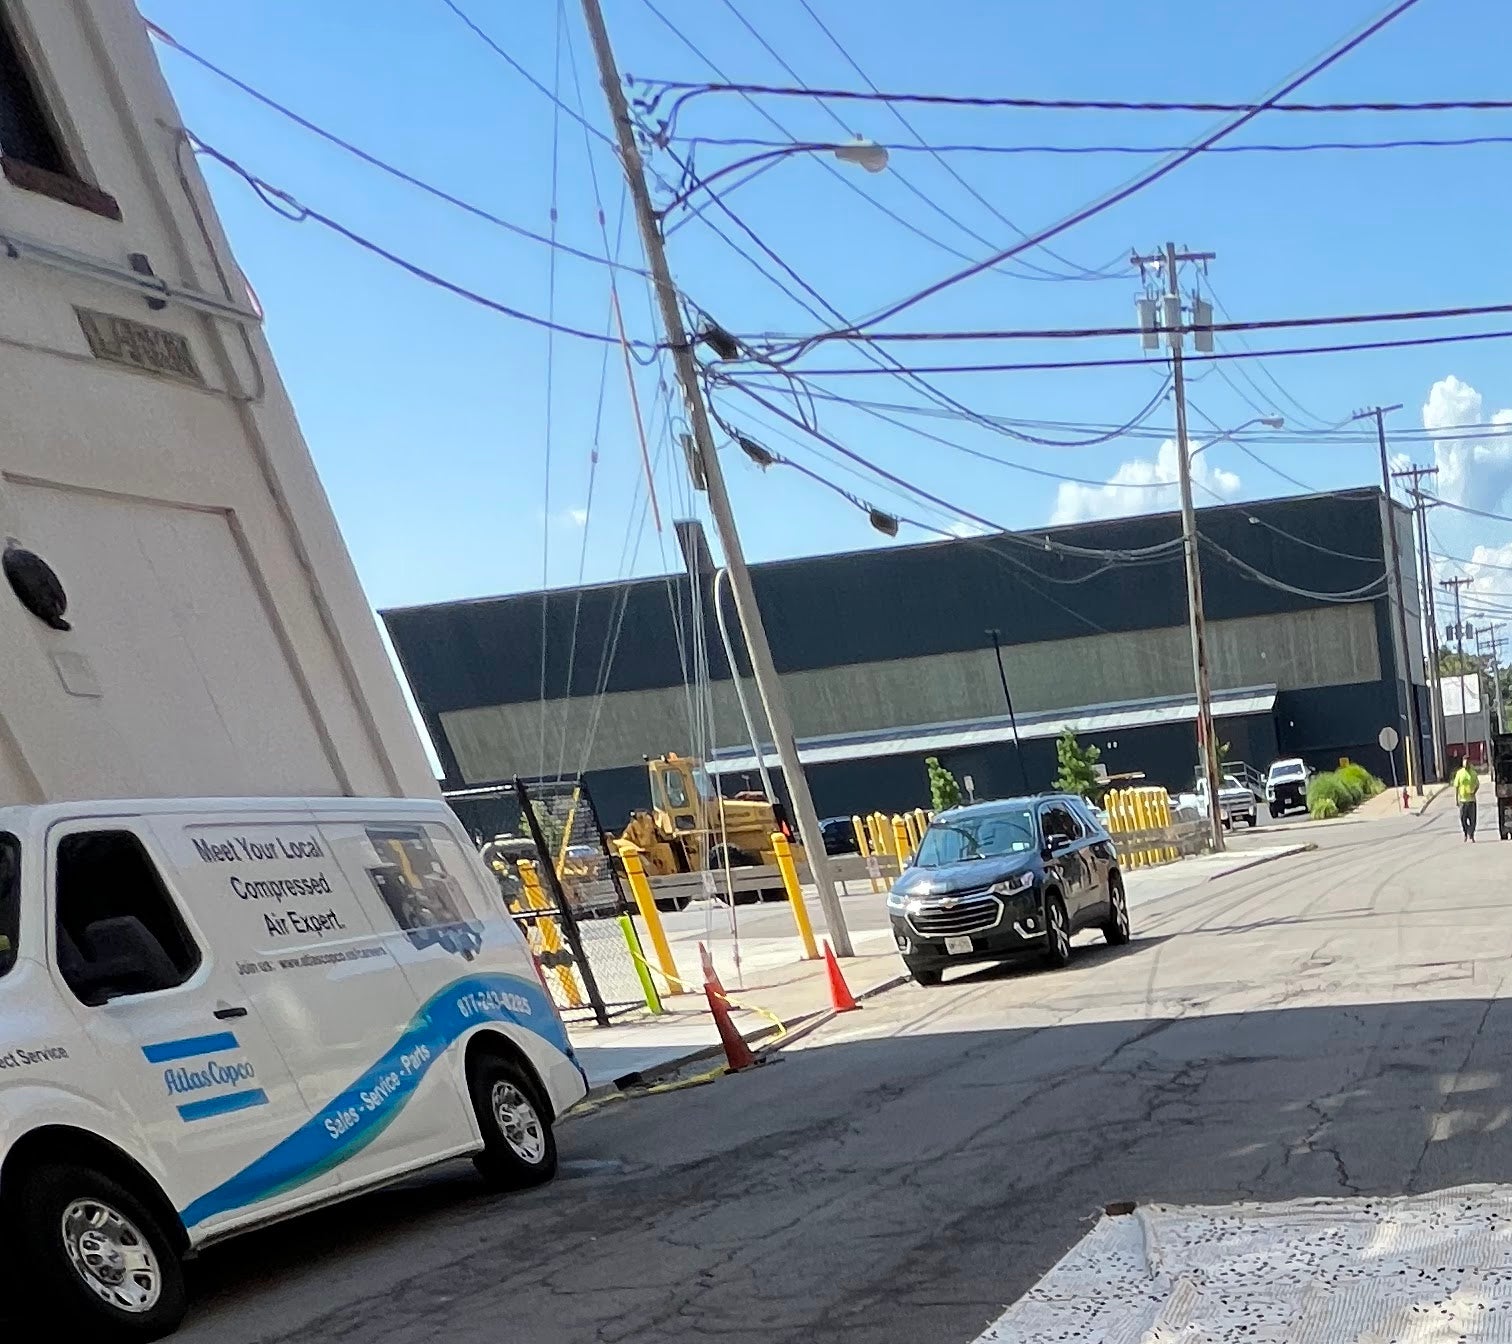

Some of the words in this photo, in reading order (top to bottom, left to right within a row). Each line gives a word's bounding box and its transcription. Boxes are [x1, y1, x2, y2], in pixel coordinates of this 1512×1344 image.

[191, 838, 237, 863] Meet
[234, 837, 279, 861] Your
[275, 834, 325, 859] Local
[230, 872, 333, 903] Compressed
[263, 911, 288, 937] Air
[286, 908, 347, 938] Expert.
[16, 1046, 70, 1065] Service
[324, 1106, 360, 1140] Sales
[359, 1071, 401, 1111] Service
[402, 1044, 431, 1075] Parts
